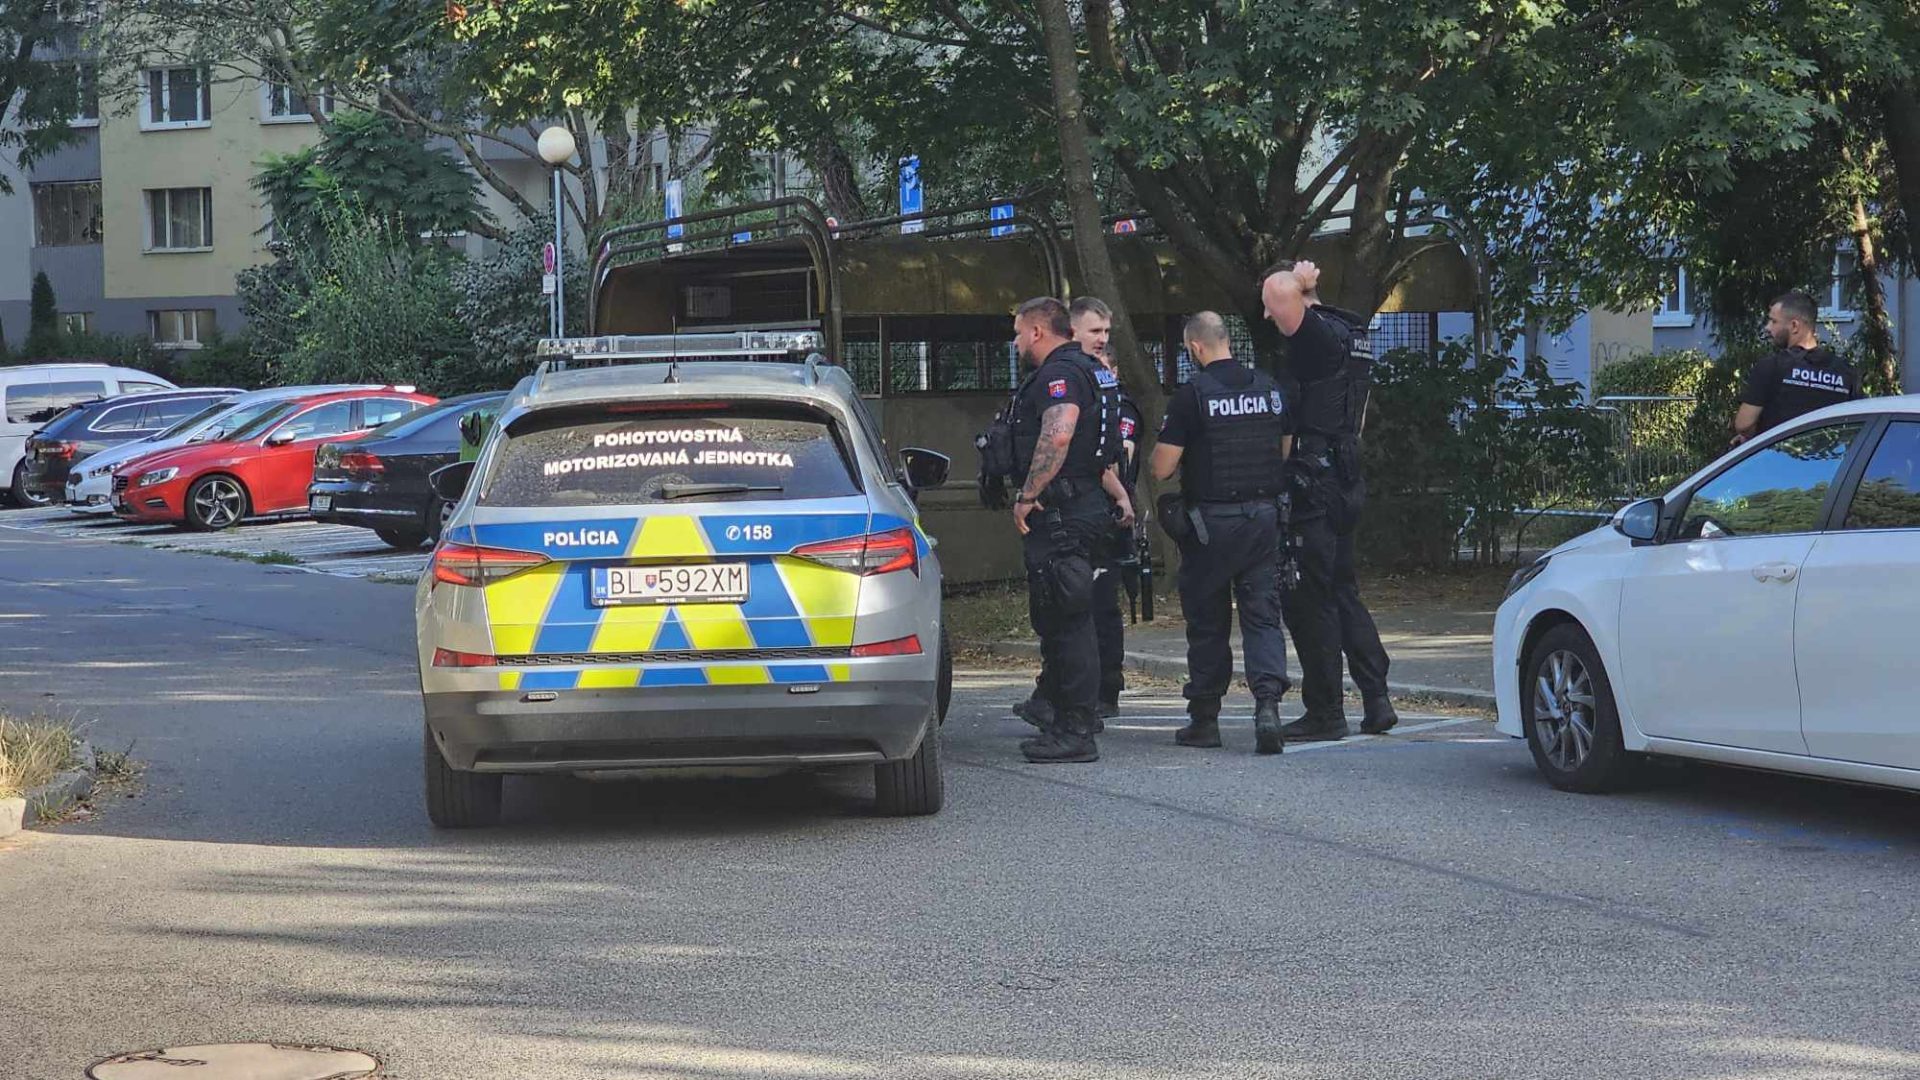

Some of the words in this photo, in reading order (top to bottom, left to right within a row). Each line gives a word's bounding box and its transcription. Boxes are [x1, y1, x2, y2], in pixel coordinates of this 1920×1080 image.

[1792, 368, 1844, 386] POLÍCIA
[1208, 394, 1269, 417] POLÍCIA
[593, 427, 743, 448] POHOTOVOSTNÁ
[544, 449, 689, 476] MOTORIZOVANÁ
[693, 452, 794, 468] JEDNOTKA
[543, 528, 619, 547] POLÍCIA
[742, 525, 773, 541] 158
[611, 570, 643, 595] BL
